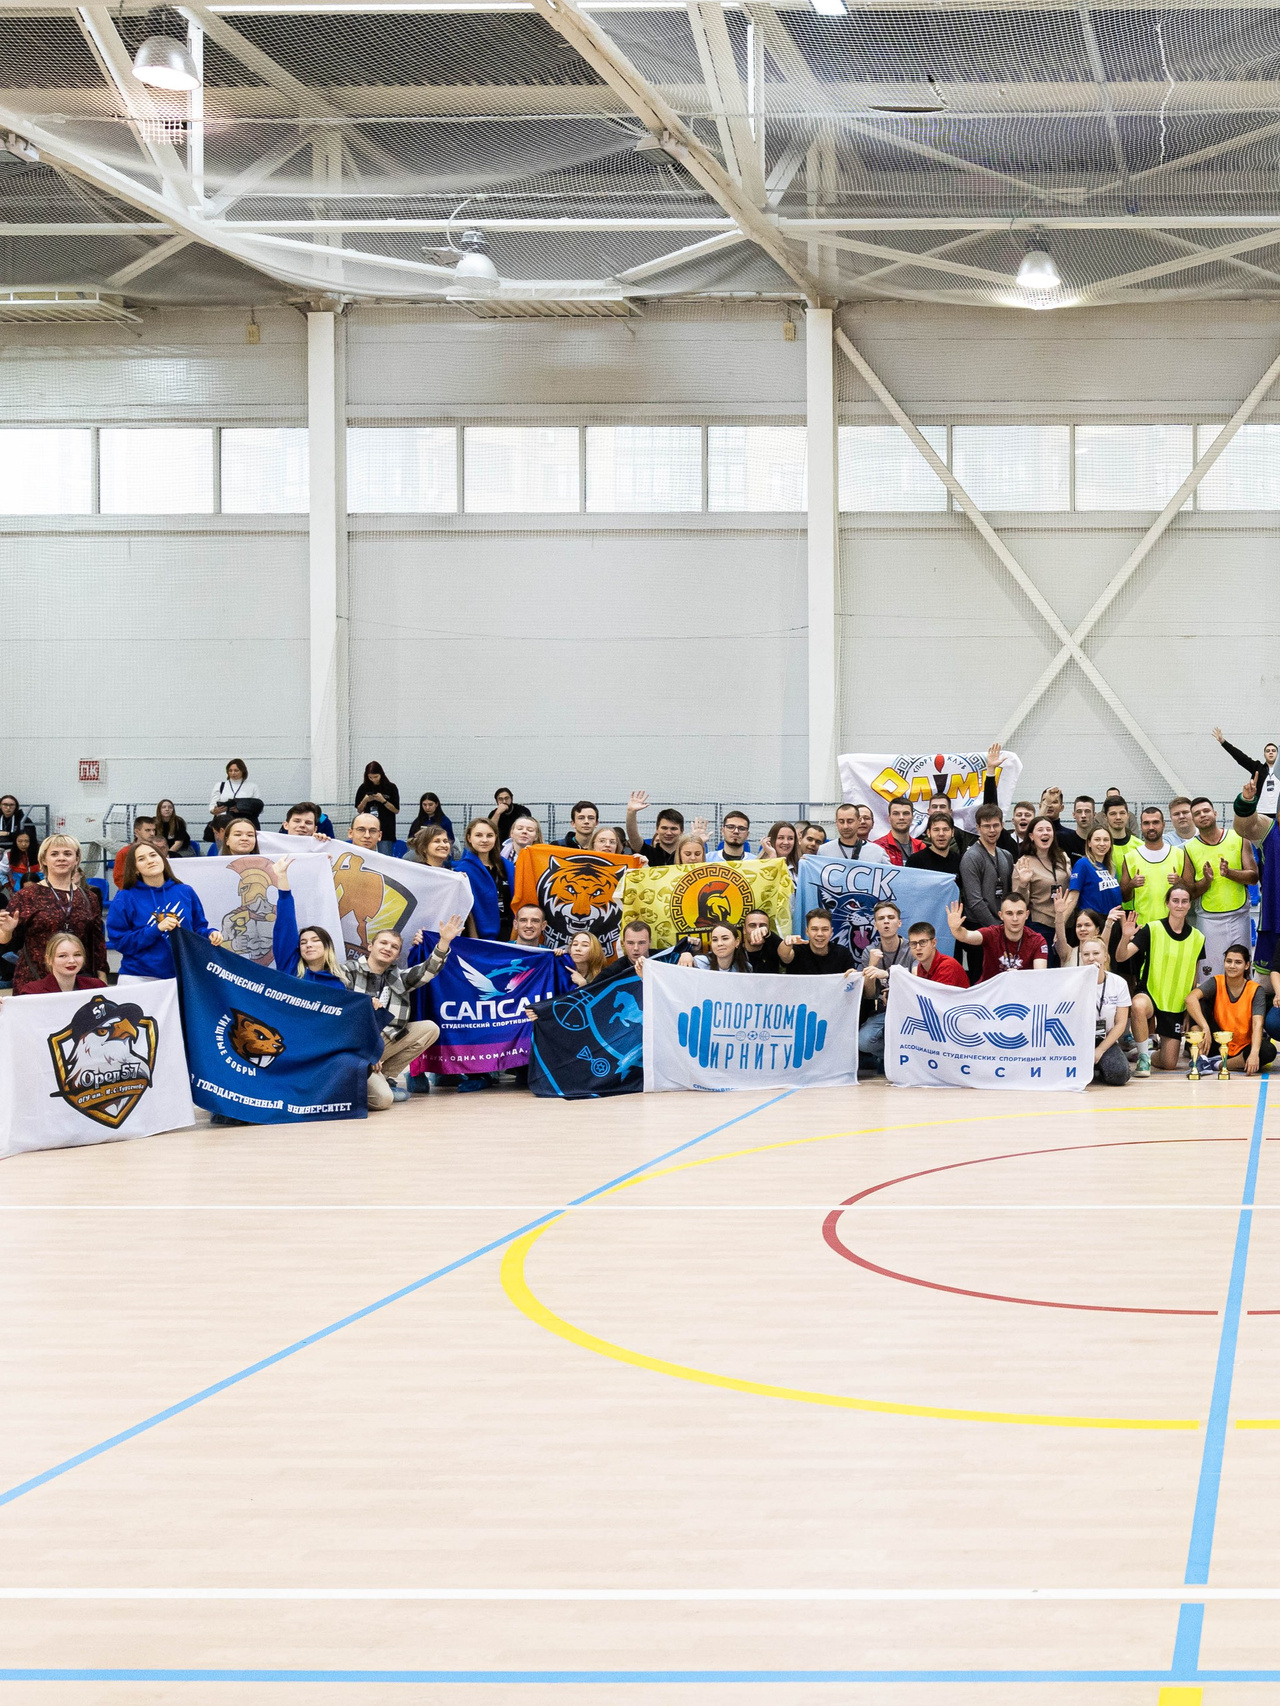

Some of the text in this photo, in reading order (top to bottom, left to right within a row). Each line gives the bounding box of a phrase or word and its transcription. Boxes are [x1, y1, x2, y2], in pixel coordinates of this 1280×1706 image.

[80, 764, 99, 777] ПК
[821, 863, 901, 901] ССК
[206, 962, 343, 1016] СТУДЕНЧЕСКИЙ СПОРТИВНЫЙ КЛУБ
[92, 1004, 106, 1019] 57
[713, 1001, 795, 1030] СПОРТКОМ
[900, 994, 1075, 1050] АССК
[479, 1047, 528, 1062] КОМАНДА,
[710, 1042, 793, 1070] ИРНИТУ
[900, 1044, 940, 1056] АССОЦИАЦИЯ
[942, 1051, 996, 1061] СТУДЕНЧЕСКИХ
[225, 1055, 256, 1077] БОБРЫ
[900, 1055, 1077, 1078] РОССИИ
[196, 1078, 284, 1110] ГОСУДАРСТВЕННЫЙ
[287, 1102, 352, 1114] УНИВЕРСИТЕТ
